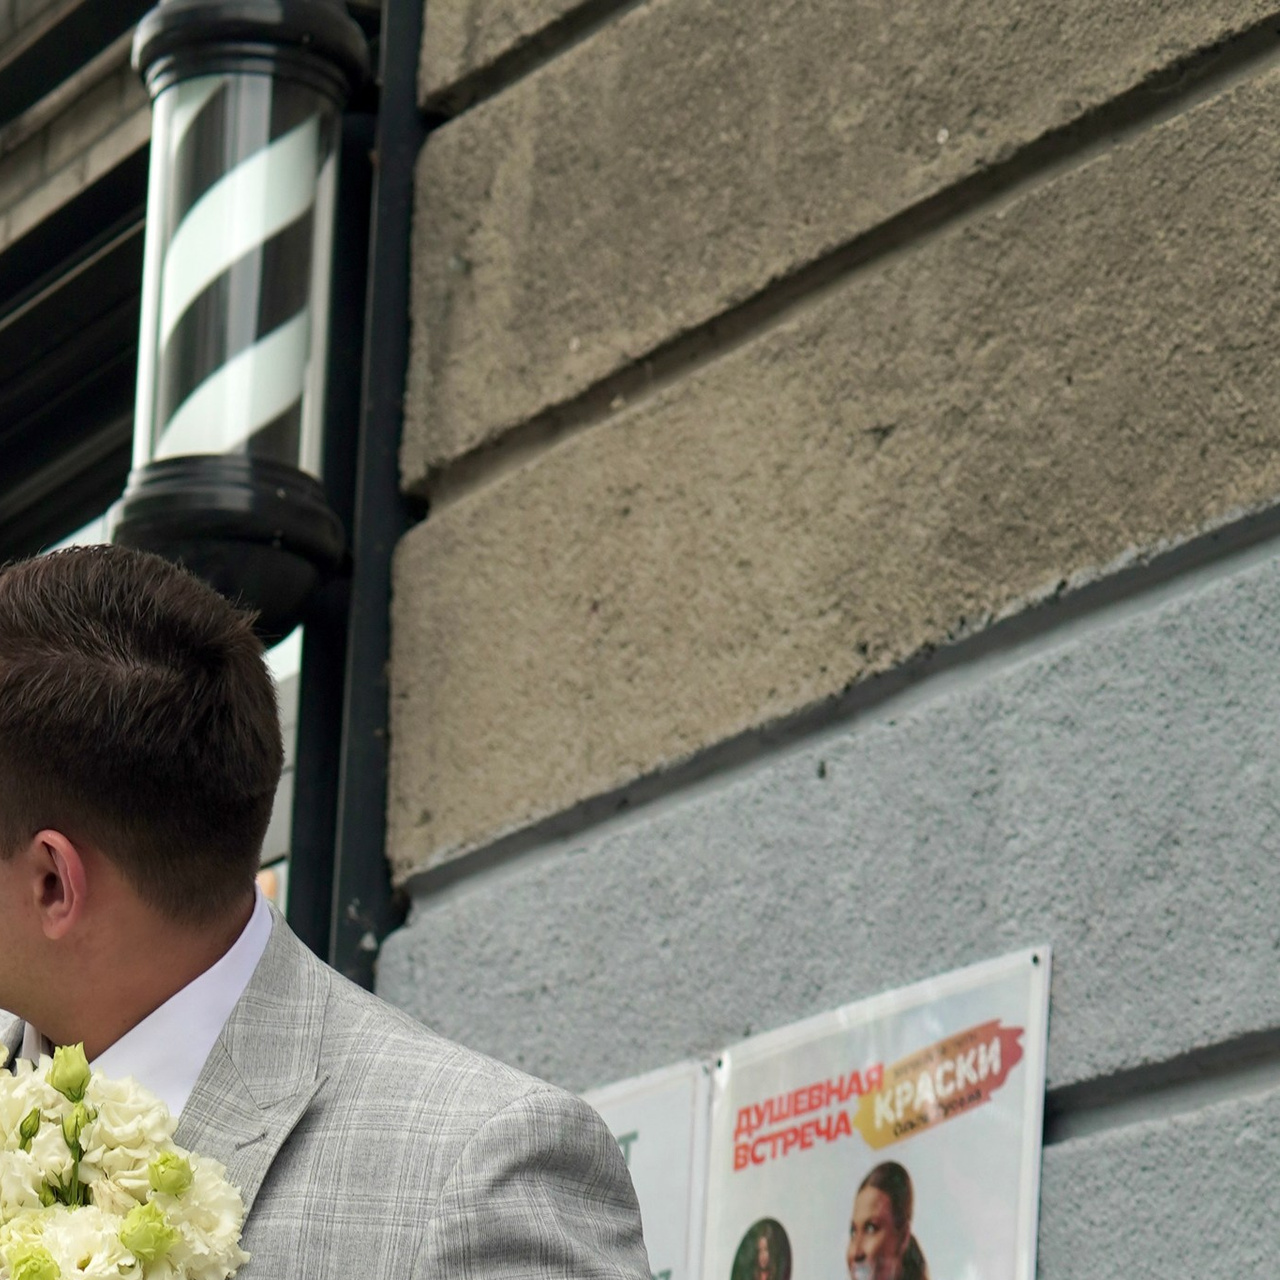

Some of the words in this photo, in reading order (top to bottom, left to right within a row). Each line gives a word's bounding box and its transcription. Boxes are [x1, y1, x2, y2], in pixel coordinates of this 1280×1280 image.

[733, 1062, 884, 1141] ДУШЕВНАЯ
[873, 1036, 1002, 1131] КРАСКИ
[733, 1109, 853, 1172] ВСТРЕЧА
